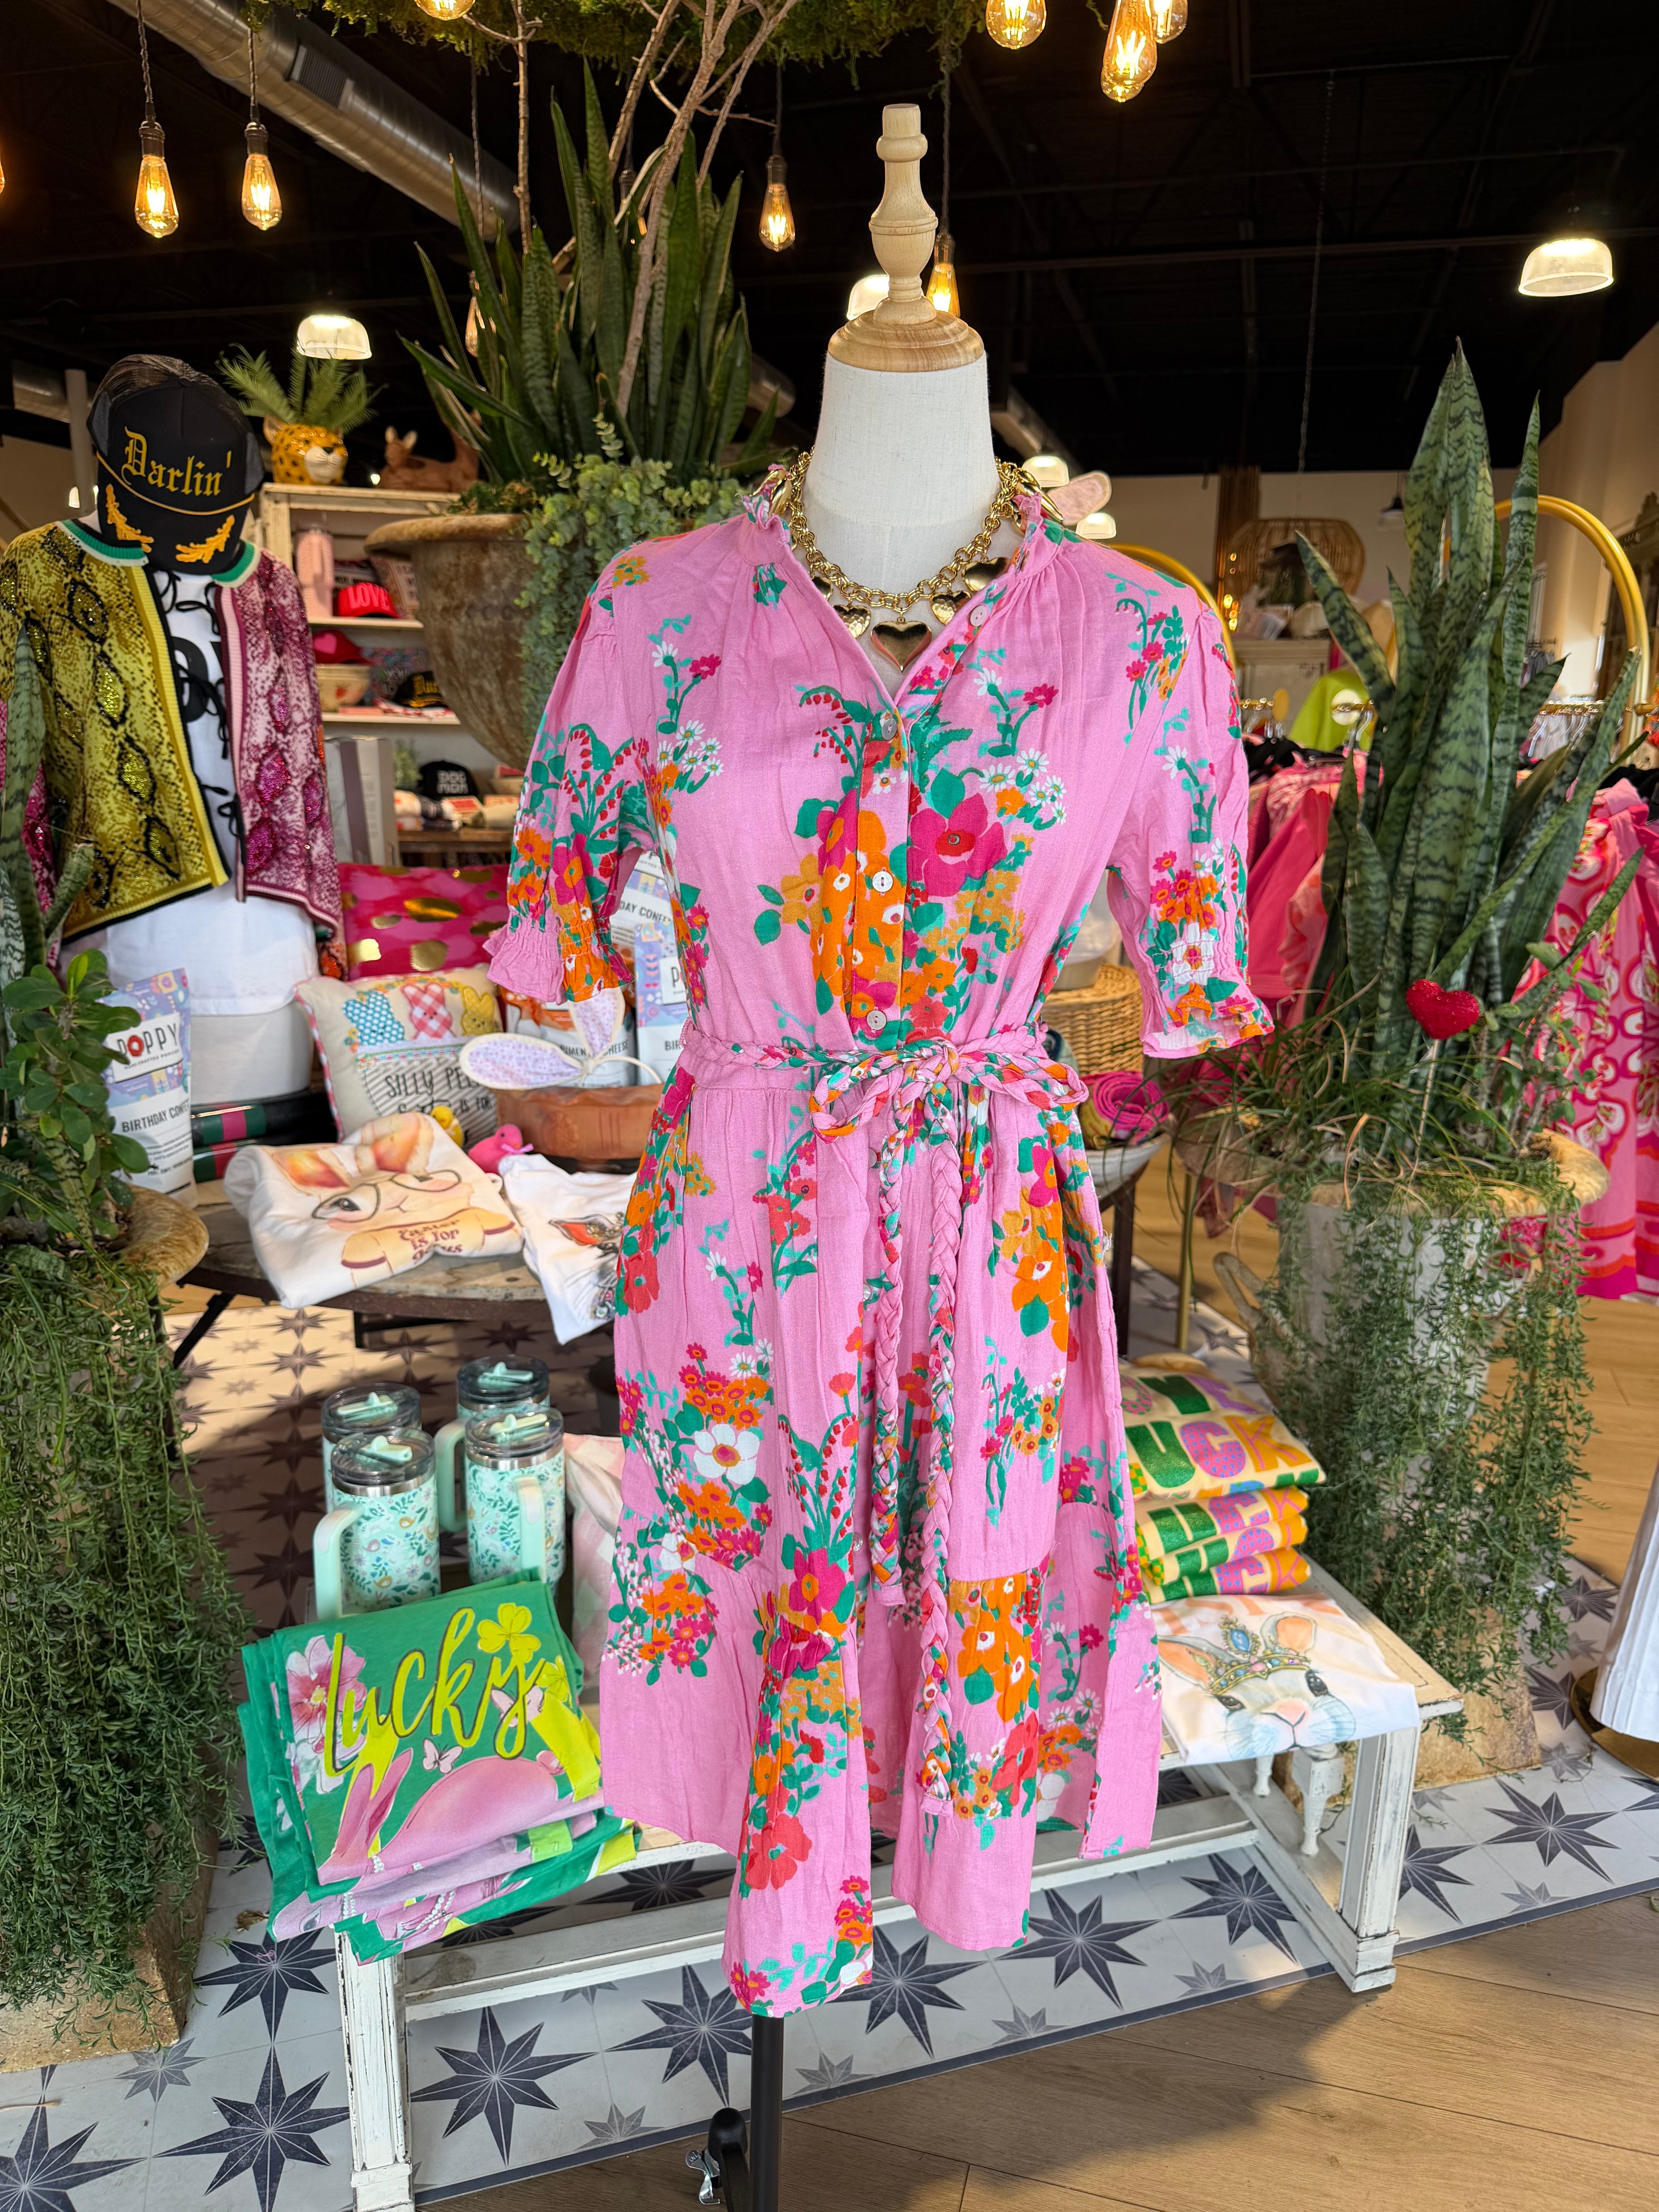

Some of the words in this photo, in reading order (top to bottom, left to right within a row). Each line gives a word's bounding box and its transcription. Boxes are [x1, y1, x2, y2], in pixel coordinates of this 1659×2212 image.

[121, 426, 232, 496] Darlin'
[347, 583, 391, 612] LOVE
[117, 1023, 177, 1057] POPPY
[384, 1070, 434, 1098] SILLY
[122, 1109, 168, 1133] BIRTHDAY
[1120, 1374, 1259, 1416] OVE
[1125, 1416, 1313, 1492] UCK
[323, 1606, 546, 1777] Lucky
